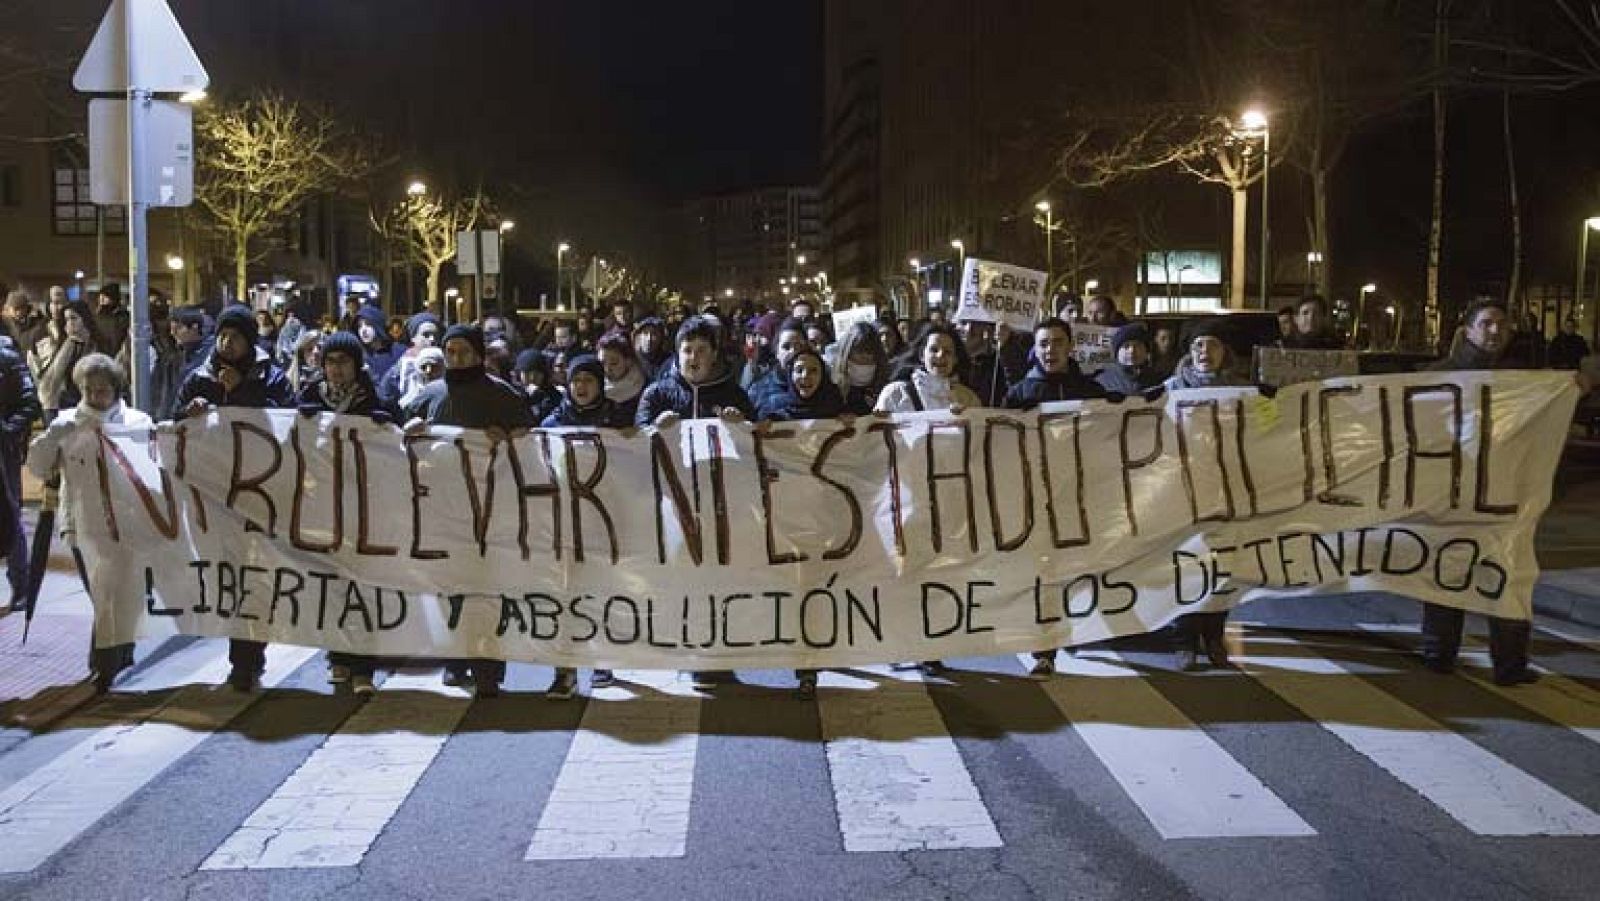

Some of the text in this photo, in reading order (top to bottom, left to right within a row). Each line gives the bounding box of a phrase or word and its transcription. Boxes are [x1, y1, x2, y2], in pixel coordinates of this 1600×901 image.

[971, 268, 1039, 295] BLEVAR
[96, 424, 208, 542] NI
[651, 424, 731, 566] NI
[751, 411, 1090, 564] ESTADO
[1120, 384, 1518, 536] POLICIAL
[146, 560, 407, 633] LIBERTAD
[495, 573, 883, 650] ABSOLUCIÓN
[921, 581, 993, 639] DE
[1034, 573, 1138, 624] LOS
[1172, 527, 1508, 606] DETENIDOS
